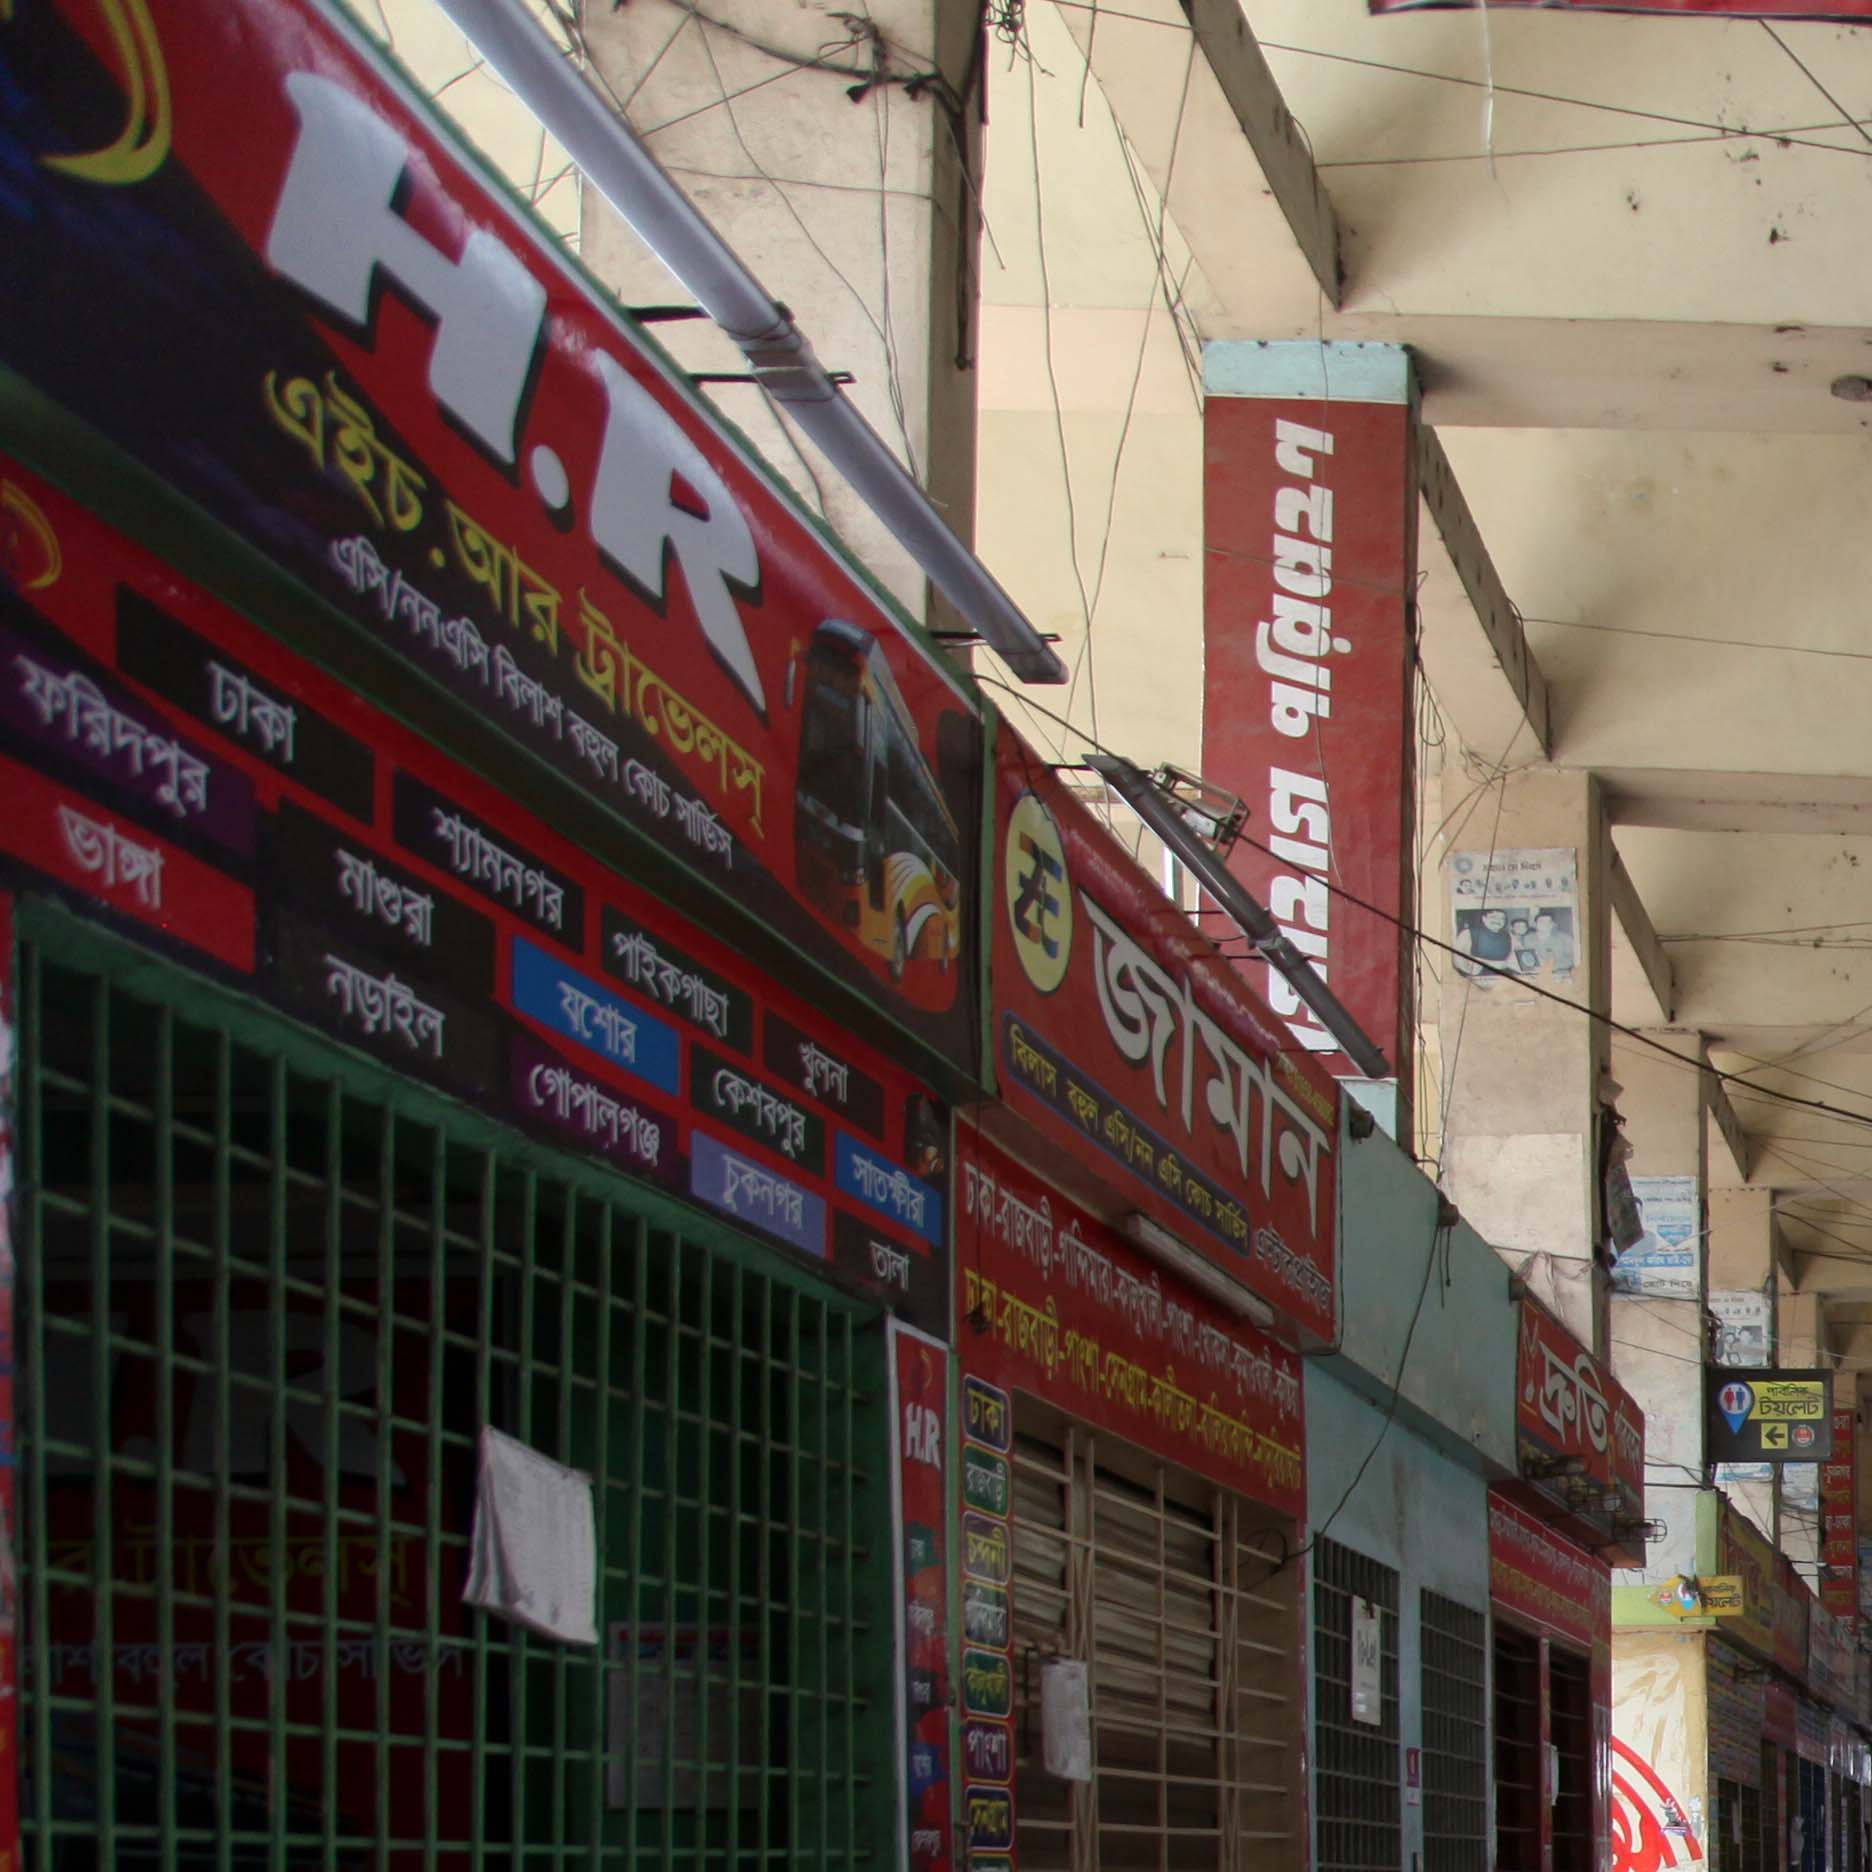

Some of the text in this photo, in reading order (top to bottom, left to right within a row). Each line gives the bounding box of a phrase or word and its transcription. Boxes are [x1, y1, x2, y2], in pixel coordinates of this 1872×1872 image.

[262, 73, 767, 713] H.R
[15, 654, 210, 817] ফরিদপুর
[209, 660, 297, 762] ঢাকা
[58, 807, 165, 911] ভাঙ্গা
[337, 849, 433, 948] মাগুরা
[433, 807, 565, 932] শ্যামনগর
[326, 955, 446, 1057] নড়াইল
[558, 978, 639, 1064] যশোর
[613, 929, 729, 1040] পাইকগাছা
[712, 1070, 807, 1153] কেশবপুর
[798, 1040, 848, 1103] খুলনা
[1082, 891, 1330, 1235] জামান
[529, 1062, 661, 1173] গোপালগঞ্জ
[722, 1154, 804, 1231] চুকনগর
[869, 1238, 909, 1291] তালা
[967, 1387, 1004, 1440] ঢাকা
[1758, 1393, 1820, 1417] টয়লেট
